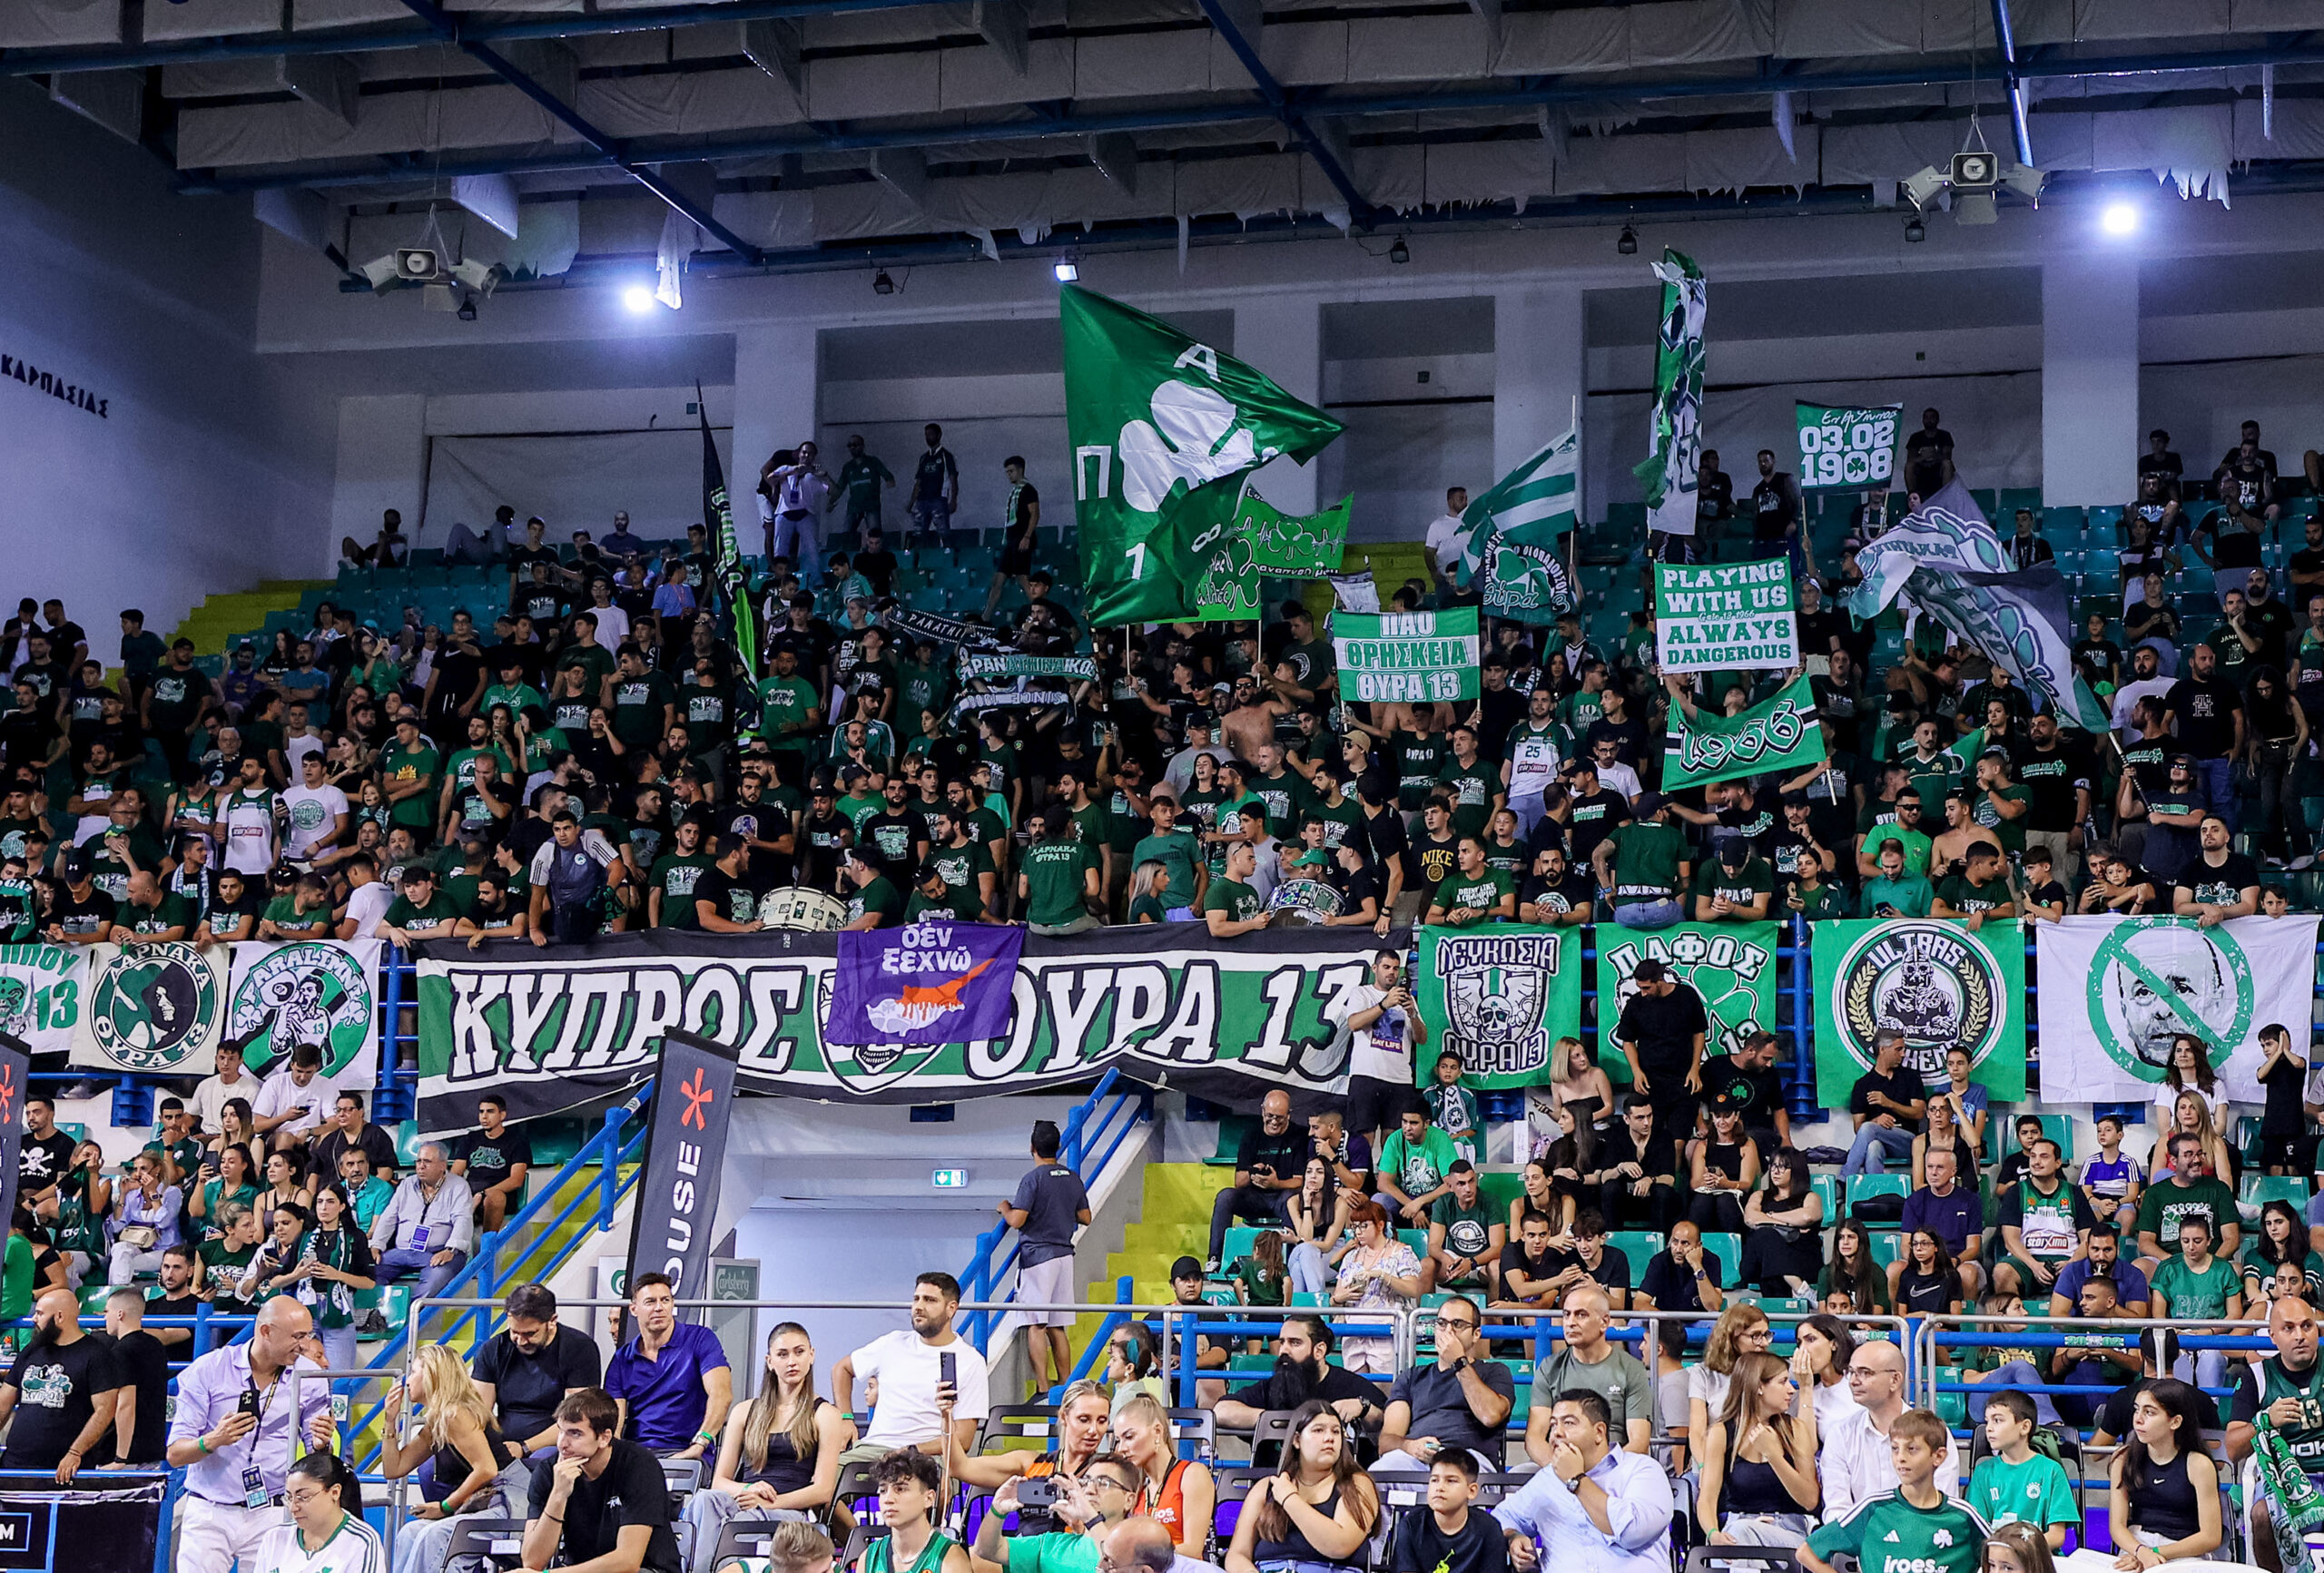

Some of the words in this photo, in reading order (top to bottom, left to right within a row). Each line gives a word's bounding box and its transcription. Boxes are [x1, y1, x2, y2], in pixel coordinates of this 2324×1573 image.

[1, 353, 109, 419] ΚΑΡΠΑΣΙΑΣ
[1799, 419, 1896, 454] 03.02
[1076, 445, 1112, 501] Π
[1800, 447, 1894, 487] 1908
[1662, 561, 1787, 588] PLAYING
[1664, 590, 1743, 614] WITH
[1750, 585, 1788, 608] US
[1380, 612, 1435, 637] ΠΑΟ
[1667, 619, 1791, 644] ALWAYS
[970, 656, 1098, 679] PANATHINAIKOS
[1346, 639, 1470, 669] ΘΡΗΣΚΕΙΑ
[1667, 644, 1792, 665] DANGEROUS
[1357, 671, 1426, 702] ΘΥΡΑ
[1428, 671, 1461, 700] 13
[1678, 698, 1805, 773] 1966
[1525, 745, 1541, 758] 25
[1420, 849, 1454, 867] NIKE
[1467, 897, 1490, 908] TODAY
[1437, 937, 1559, 977] ΛΕΥΚΩΣΙΑ
[1605, 931, 1769, 981] ΠΑΦΟΣ
[34, 979, 79, 1032] 13
[448, 964, 807, 1082] ΚΥΠΡΟΣ
[1242, 959, 1371, 1082] 13
[94, 1015, 172, 1067] ΘΥΡΑ
[177, 1022, 207, 1057] 13
[312, 1023, 324, 1034] 13
[1385, 1040, 1402, 1050] LIFE
[1519, 1029, 1547, 1070] 13
[665, 1139, 702, 1316] OUSE
[715, 1267, 750, 1295] Carlsberg
[1990, 1487, 2000, 1500] 10
